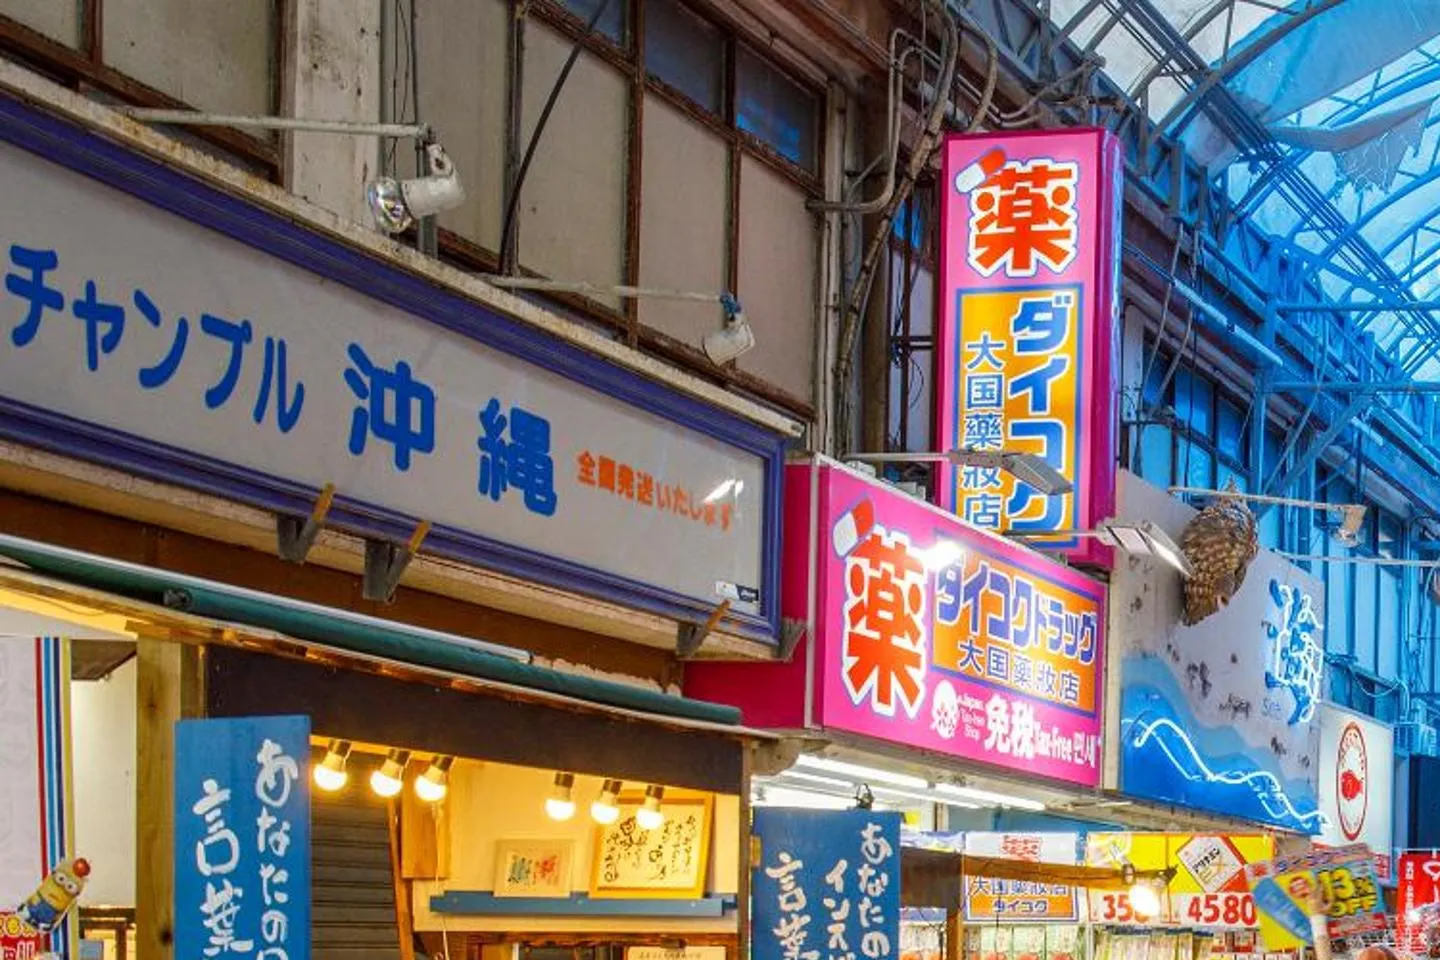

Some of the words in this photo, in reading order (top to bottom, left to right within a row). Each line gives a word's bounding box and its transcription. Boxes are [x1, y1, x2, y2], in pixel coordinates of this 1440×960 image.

[971, 157, 1077, 275] 薬
[5, 245, 305, 433] チャンプル
[345, 342, 557, 517] 沖縄
[1009, 294, 1074, 532] ダイコク
[844, 531, 926, 706] 薬
[936, 559, 1098, 665] ダイコクドラッグ
[985, 694, 1034, 760] 免税
[1188, 893, 1258, 926] 4580
